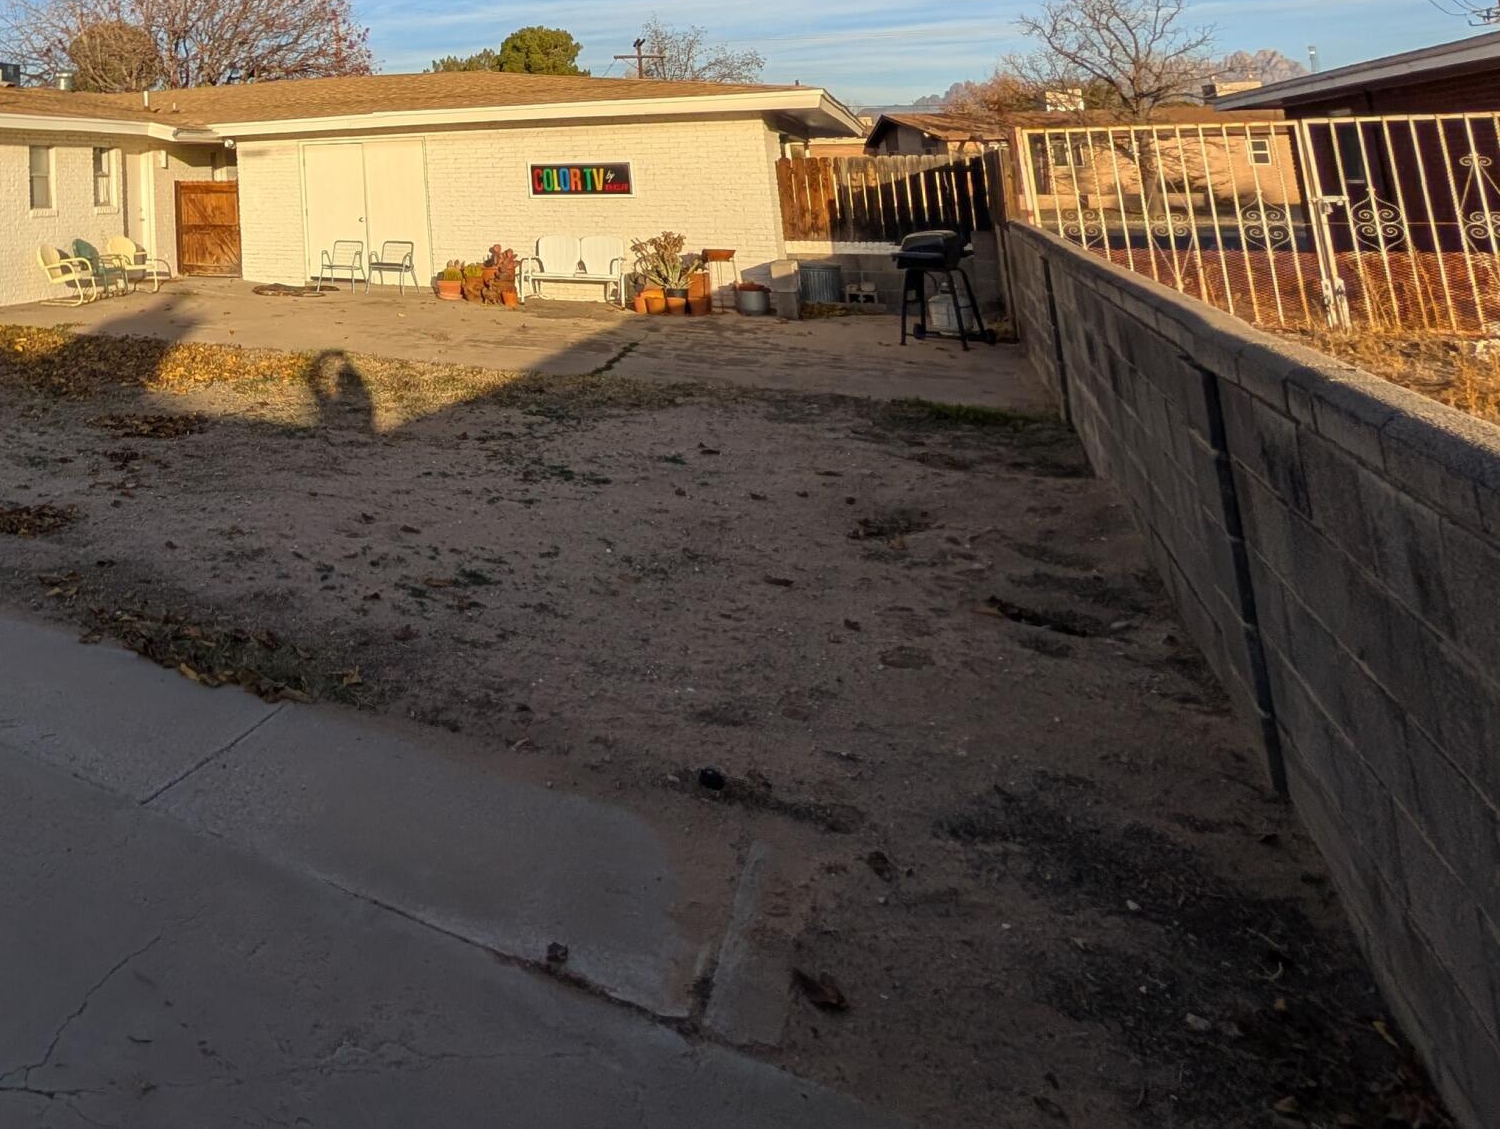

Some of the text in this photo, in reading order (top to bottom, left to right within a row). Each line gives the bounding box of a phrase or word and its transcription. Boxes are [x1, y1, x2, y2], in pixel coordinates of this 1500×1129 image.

[533, 168, 615, 191] COLOR TV by
